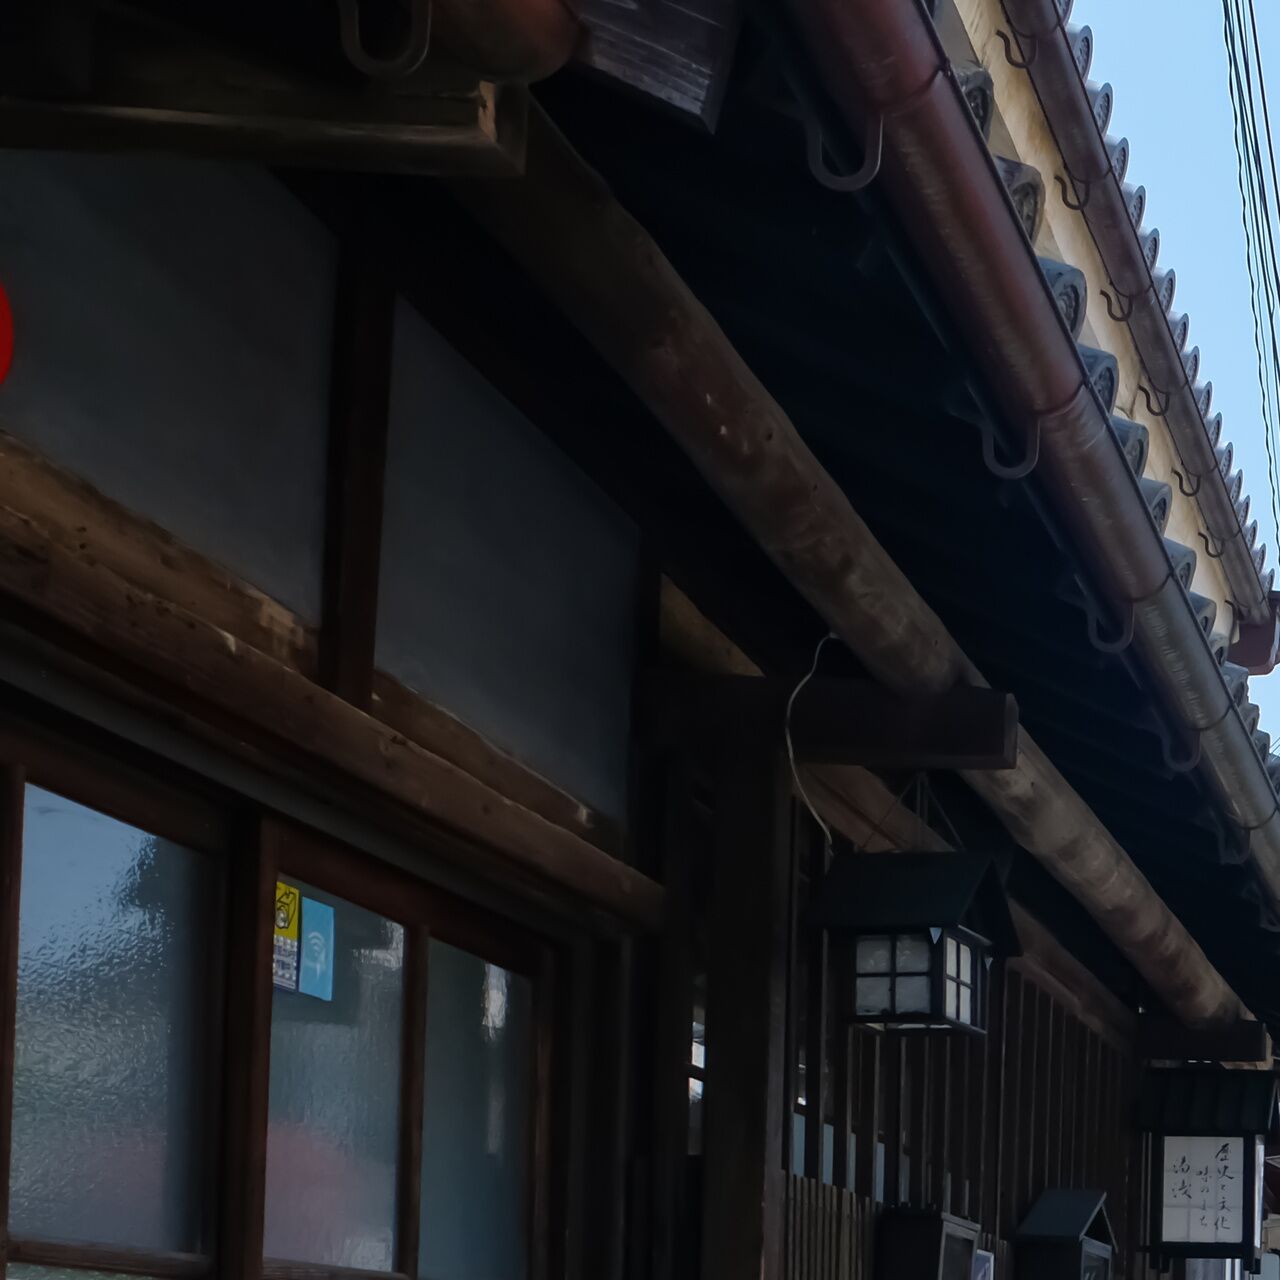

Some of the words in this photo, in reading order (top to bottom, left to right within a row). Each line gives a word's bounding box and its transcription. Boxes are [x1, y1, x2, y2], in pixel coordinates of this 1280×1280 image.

[1171, 1155, 1193, 1200] 湯浅
[1215, 1143, 1235, 1230] 歴史と文化
